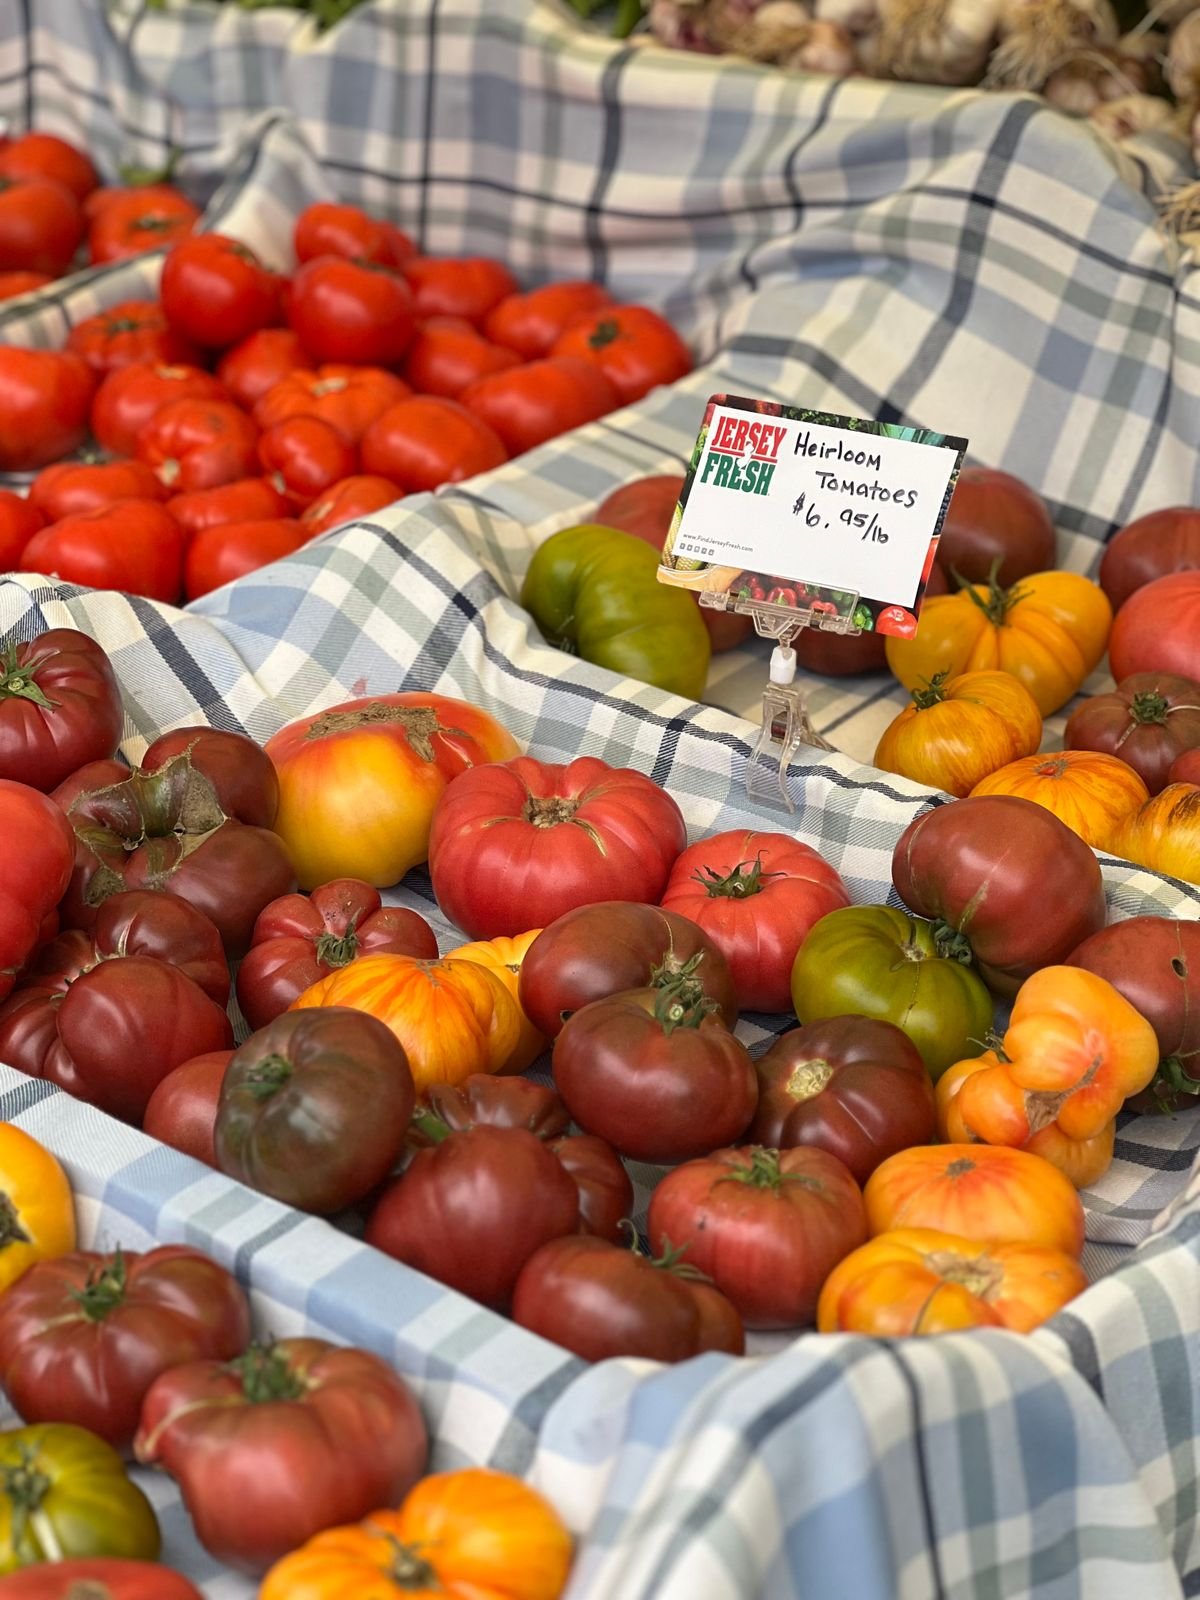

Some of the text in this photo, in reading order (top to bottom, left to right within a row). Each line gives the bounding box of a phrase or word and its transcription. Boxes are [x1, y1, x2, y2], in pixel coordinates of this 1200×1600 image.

[711, 415, 788, 458] JERSEY
[793, 431, 882, 471] Heirloom
[700, 452, 777, 496] FRESH
[815, 470, 919, 508] Tomatoes
